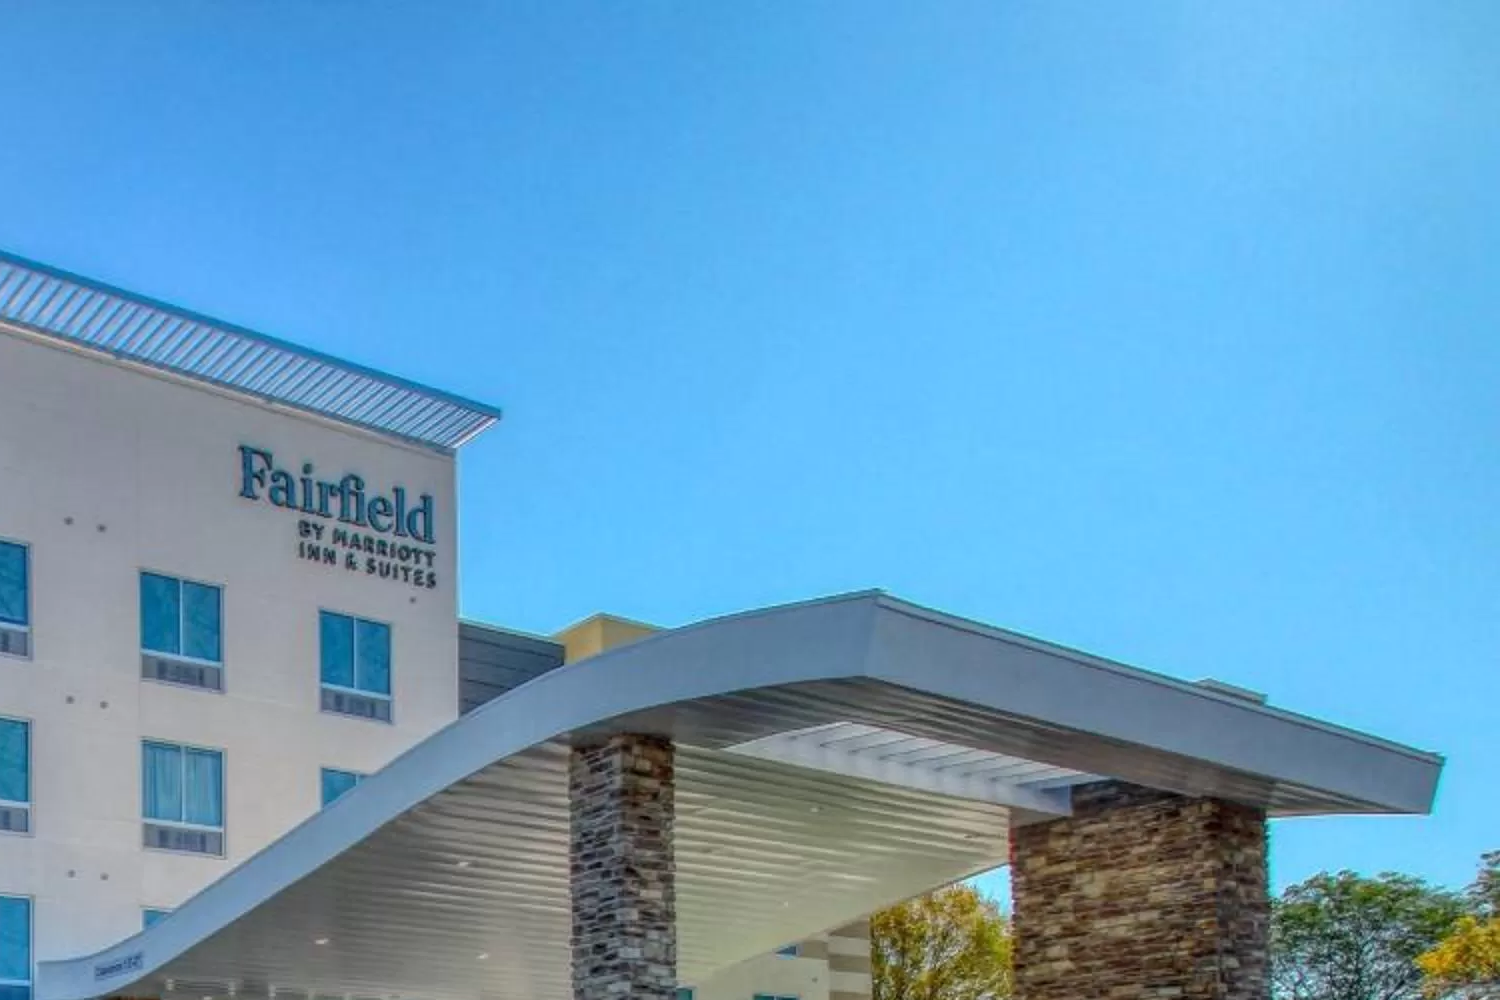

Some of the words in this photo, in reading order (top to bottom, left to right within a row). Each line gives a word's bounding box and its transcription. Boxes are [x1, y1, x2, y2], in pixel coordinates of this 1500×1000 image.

[238, 444, 437, 544] Fairfield
[298, 519, 325, 541] BY
[332, 527, 437, 567] MARRIOTT
[298, 541, 337, 566] INN
[345, 552, 357, 571] &
[366, 557, 437, 589] SUITES
